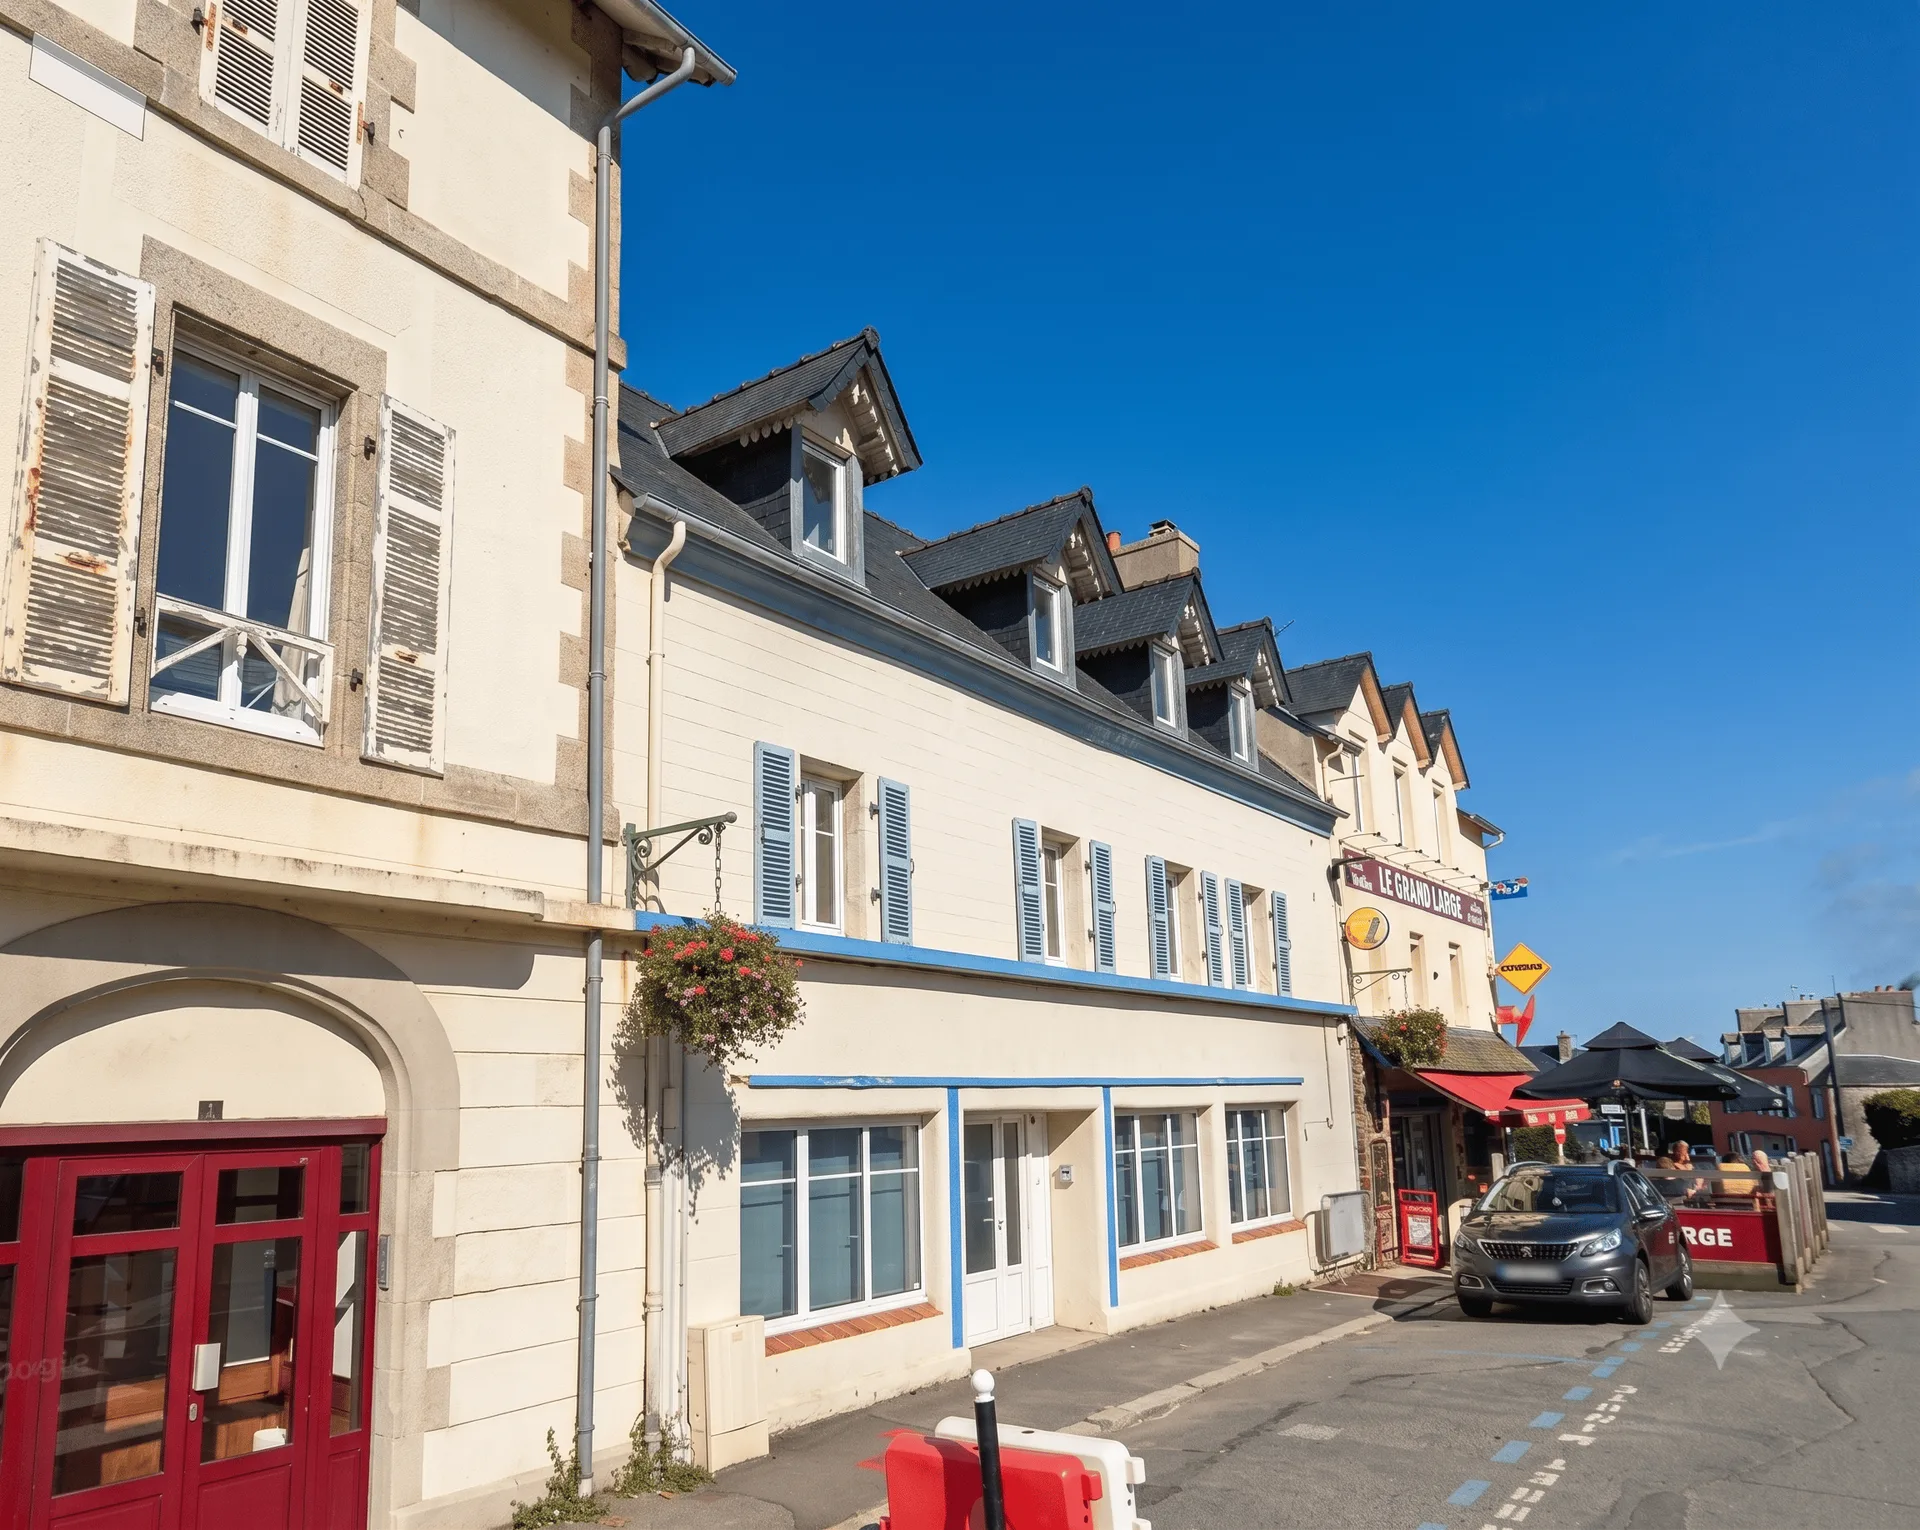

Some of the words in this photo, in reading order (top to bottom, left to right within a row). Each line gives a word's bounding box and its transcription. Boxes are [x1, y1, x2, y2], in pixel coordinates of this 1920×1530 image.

[1378, 866, 1393, 896] LE
[1394, 872, 1431, 909] GRAND
[1431, 886, 1463, 920] LARGE
[1681, 1226, 1733, 1247] RGE
